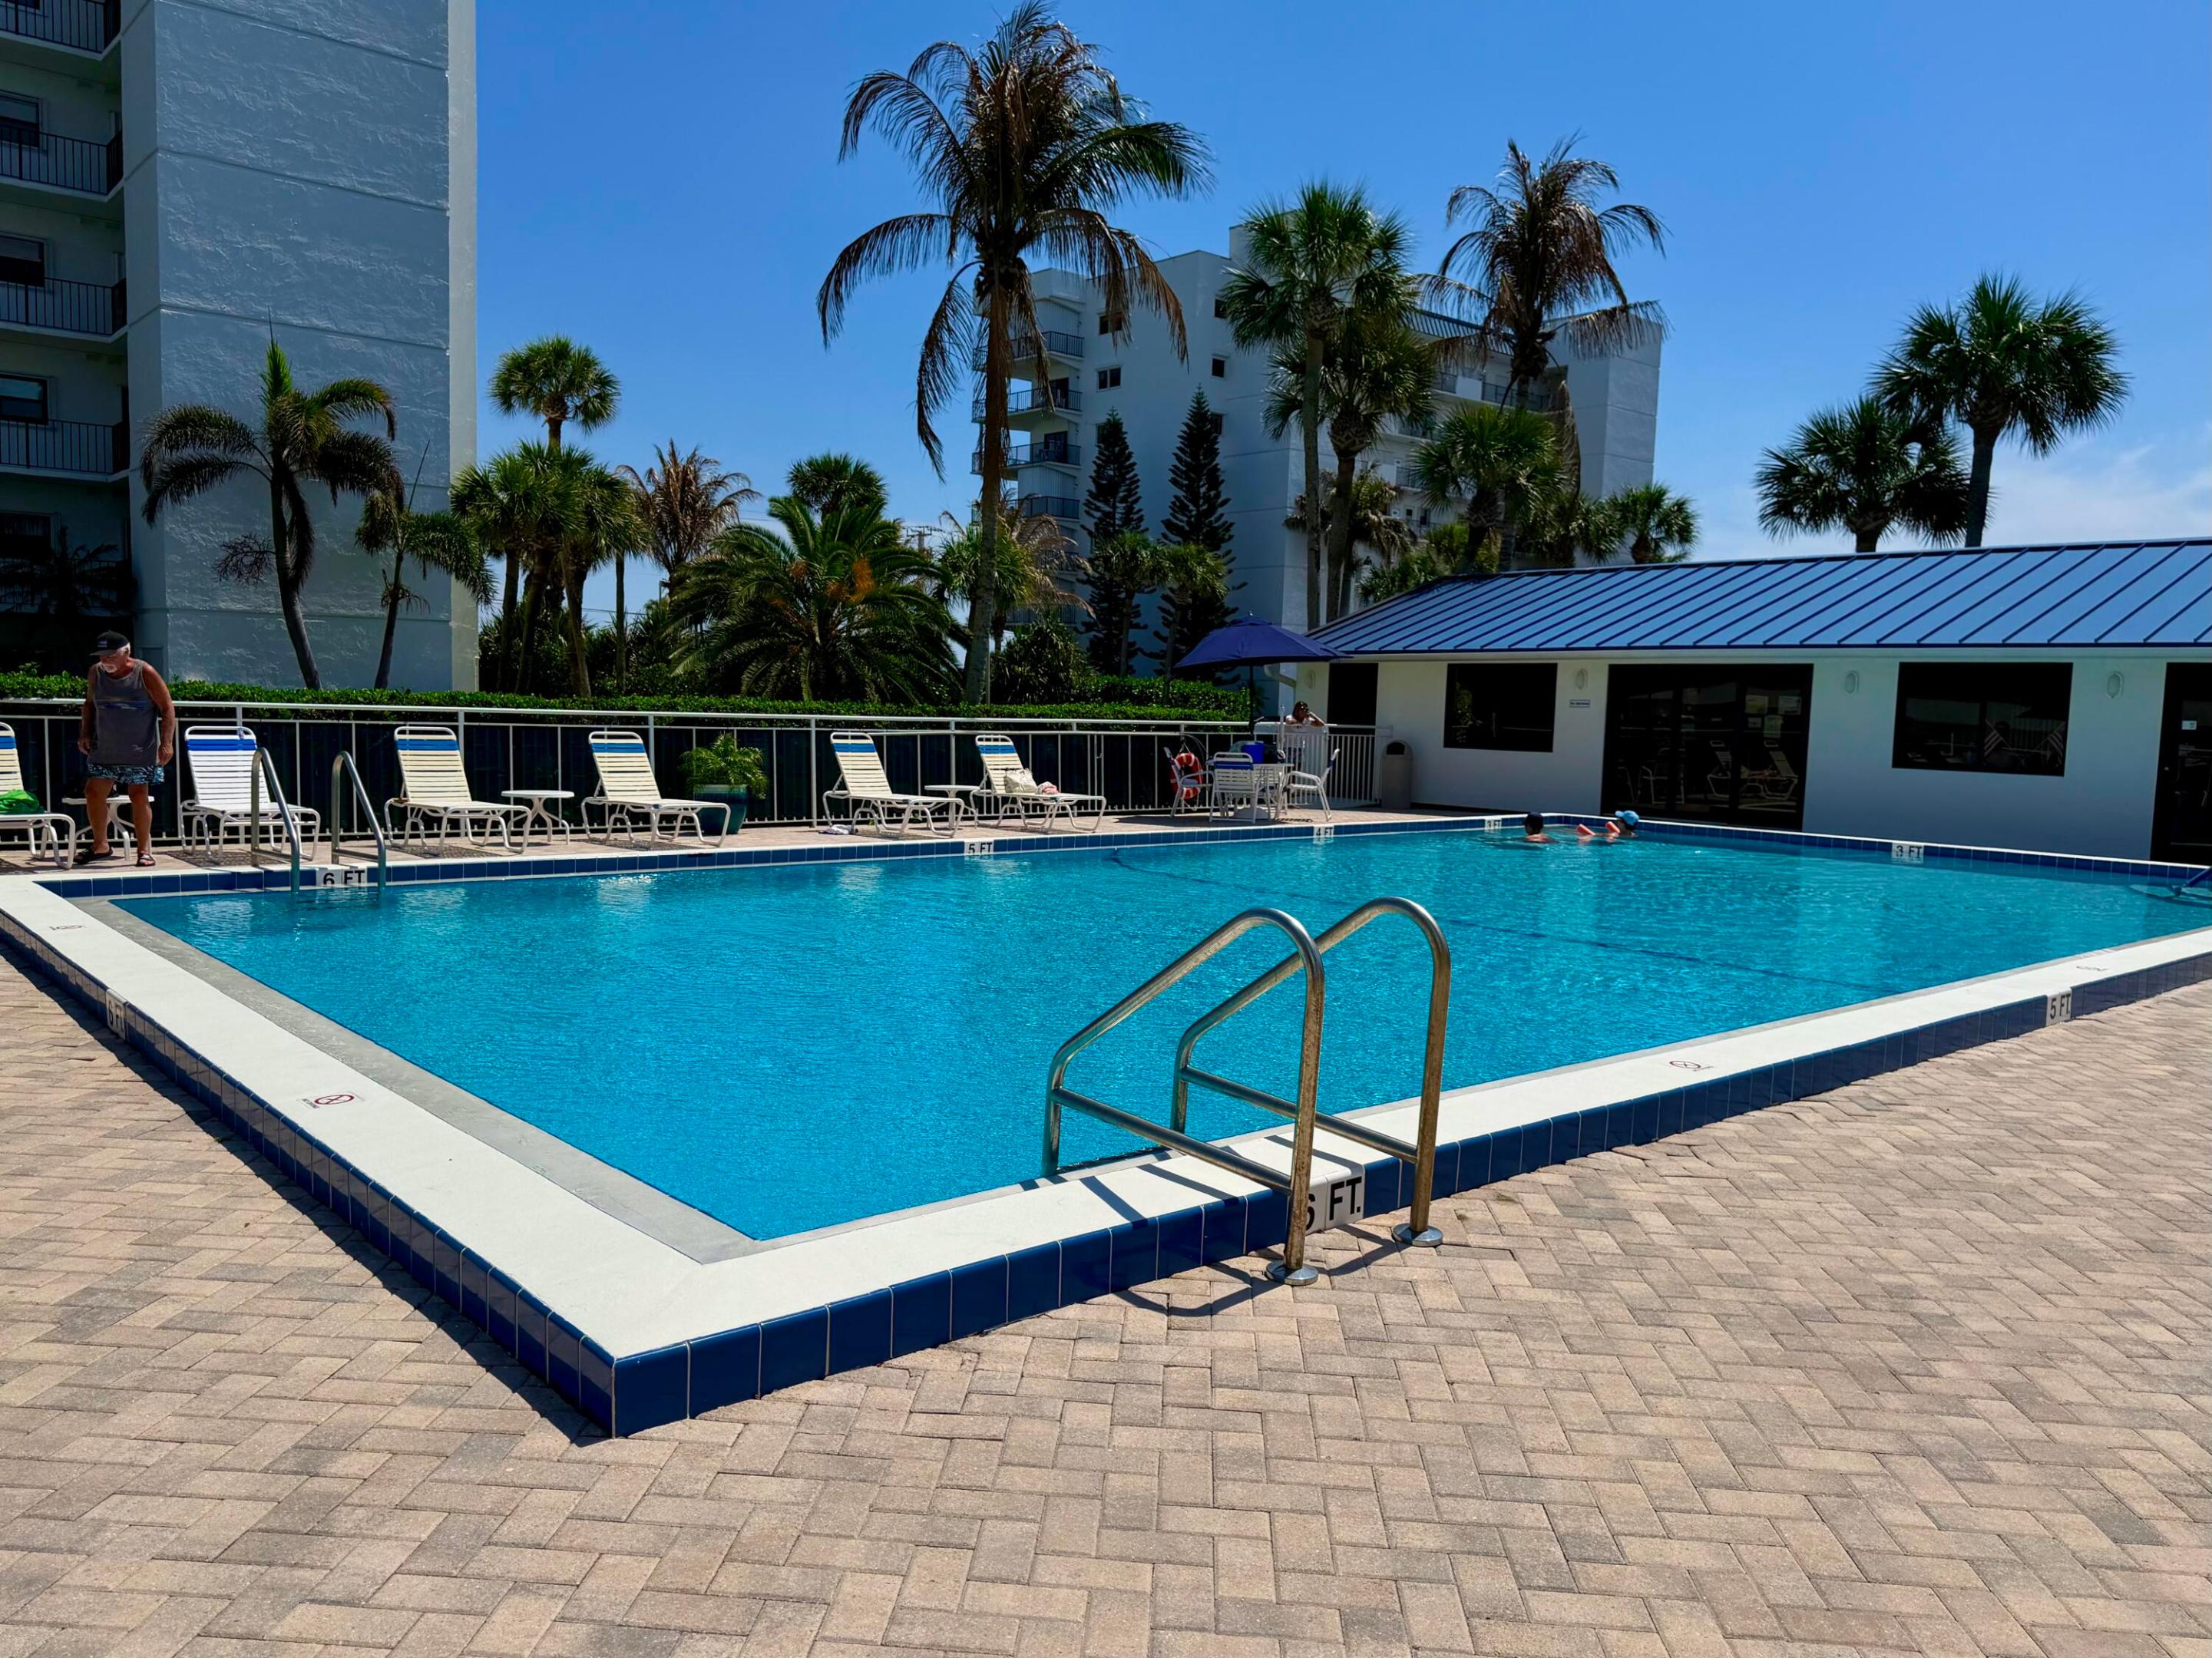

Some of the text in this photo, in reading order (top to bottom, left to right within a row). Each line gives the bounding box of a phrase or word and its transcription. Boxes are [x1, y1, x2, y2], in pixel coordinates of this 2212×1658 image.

[1493, 819, 1501, 828] FT
[1315, 827, 1334, 836] 4 FT
[968, 842, 993, 854] 5 FT
[1896, 845, 1923, 857] 3 FT
[323, 870, 365, 885] 6 FT
[2050, 998, 2057, 1019] 5
[1328, 1176, 1362, 1221] FT.
